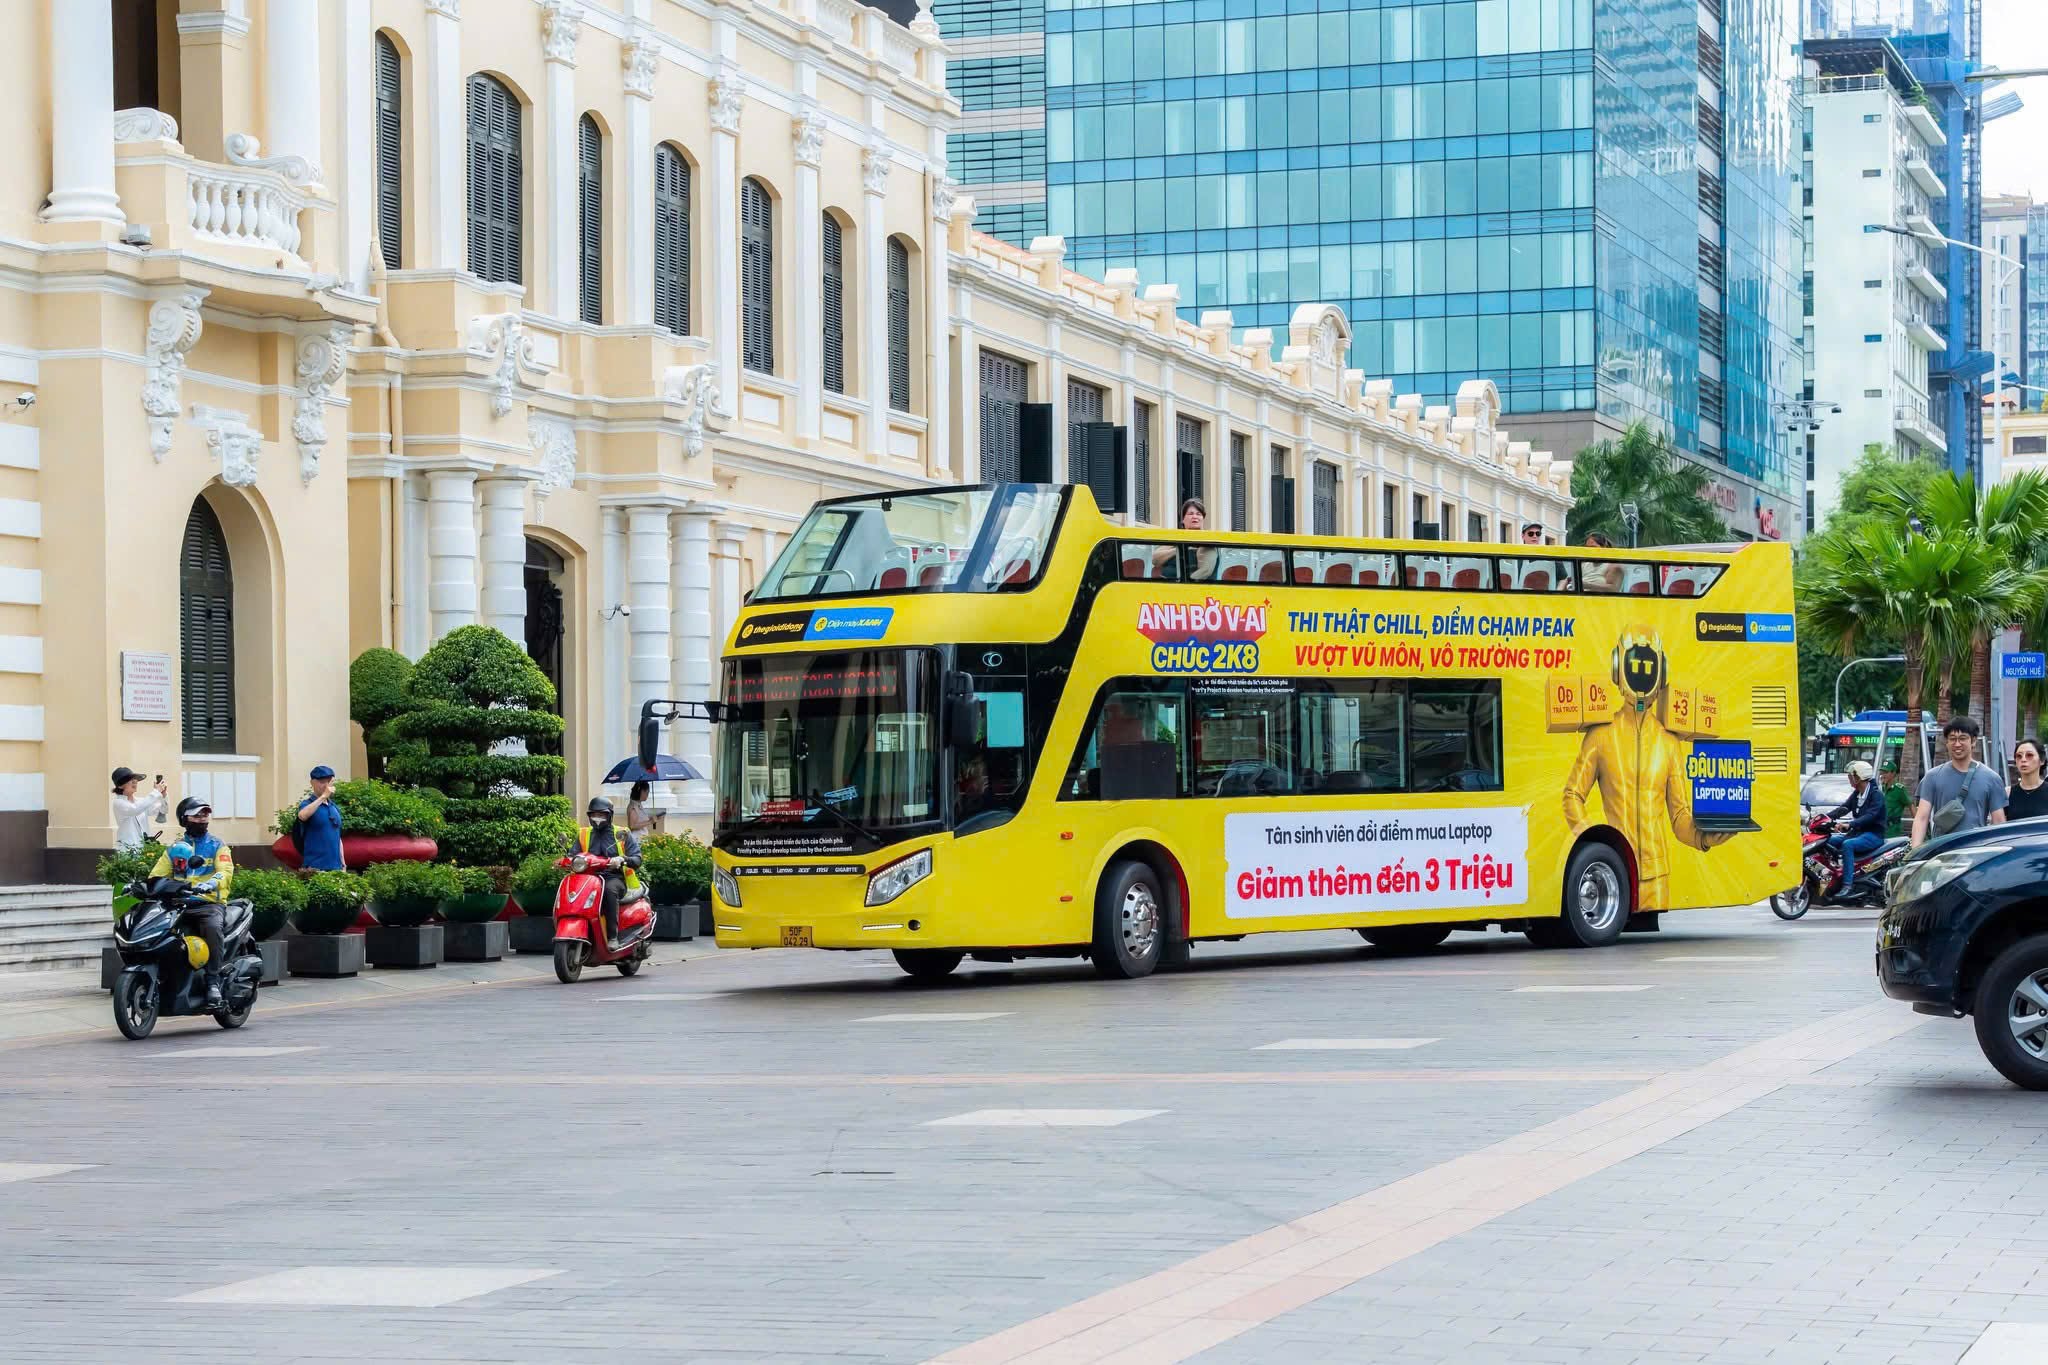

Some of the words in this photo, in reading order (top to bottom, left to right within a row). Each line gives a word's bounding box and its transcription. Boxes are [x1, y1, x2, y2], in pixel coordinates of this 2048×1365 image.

[1138, 604, 1187, 630] ANH
[1190, 598, 1222, 631] BỜ
[1224, 606, 1266, 631] V-AI
[1288, 611, 1318, 632] THI
[1323, 608, 1372, 639] THẬT
[1374, 614, 1428, 638] CHILL,
[1432, 606, 1474, 635] ĐIỂM
[1478, 616, 1528, 642] CHẠM
[1532, 618, 1575, 637] PEAK
[1154, 640, 1209, 669] CHÚC
[1213, 643, 1257, 670] 2K8
[1295, 645, 1348, 672] VƯỢT
[1352, 642, 1378, 668] VŨ
[1380, 642, 1424, 671] MÔN,
[1430, 642, 1452, 668] VÔ
[1457, 642, 1530, 669] TRƯỜNG
[1534, 648, 1570, 668] TOP!
[1558, 686, 1573, 703] 0Đ
[1590, 684, 1606, 702] 0%
[1673, 699, 1688, 716] +3
[1688, 752, 1716, 783] ĐẬU
[1696, 787, 1726, 800] LAPTOP
[1265, 828, 1292, 845] Tân
[1294, 826, 1324, 844] sinh
[1326, 826, 1354, 844] viên
[1357, 820, 1378, 842] đổi
[1380, 818, 1414, 842] điểm
[1416, 827, 1446, 841] mua
[1449, 823, 1492, 844] Laptop
[1237, 866, 1303, 900] Giảm
[1308, 865, 1372, 897] thêm
[1376, 856, 1420, 894] đến
[1425, 858, 1440, 891] 3
[1445, 854, 1513, 898] Triệu
